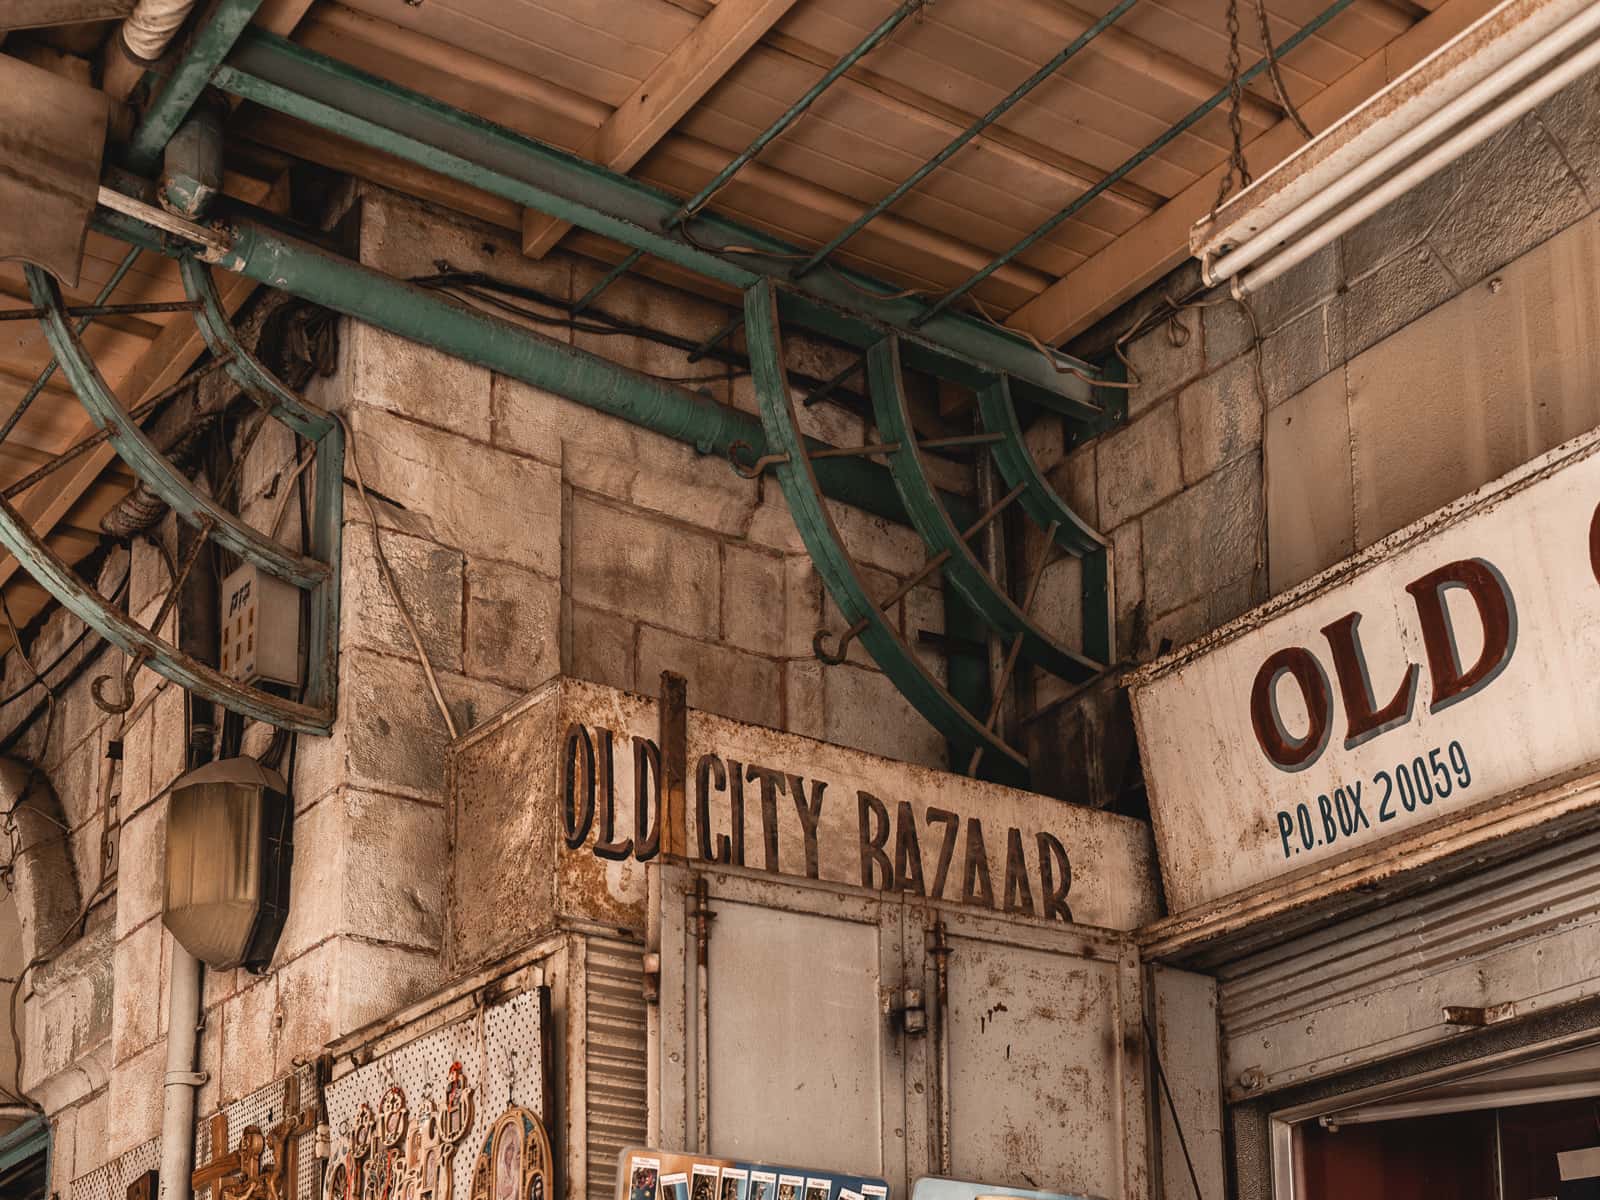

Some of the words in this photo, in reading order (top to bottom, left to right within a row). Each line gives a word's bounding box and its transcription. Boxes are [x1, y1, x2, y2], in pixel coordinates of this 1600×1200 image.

[1250, 557, 1518, 773] OLD
[561, 722, 660, 862] OLD
[695, 752, 828, 880] CITY
[857, 790, 1074, 924] BAZAAR
[1277, 781, 1369, 859] P.O.BOX
[1372, 740, 1472, 823] 20059
